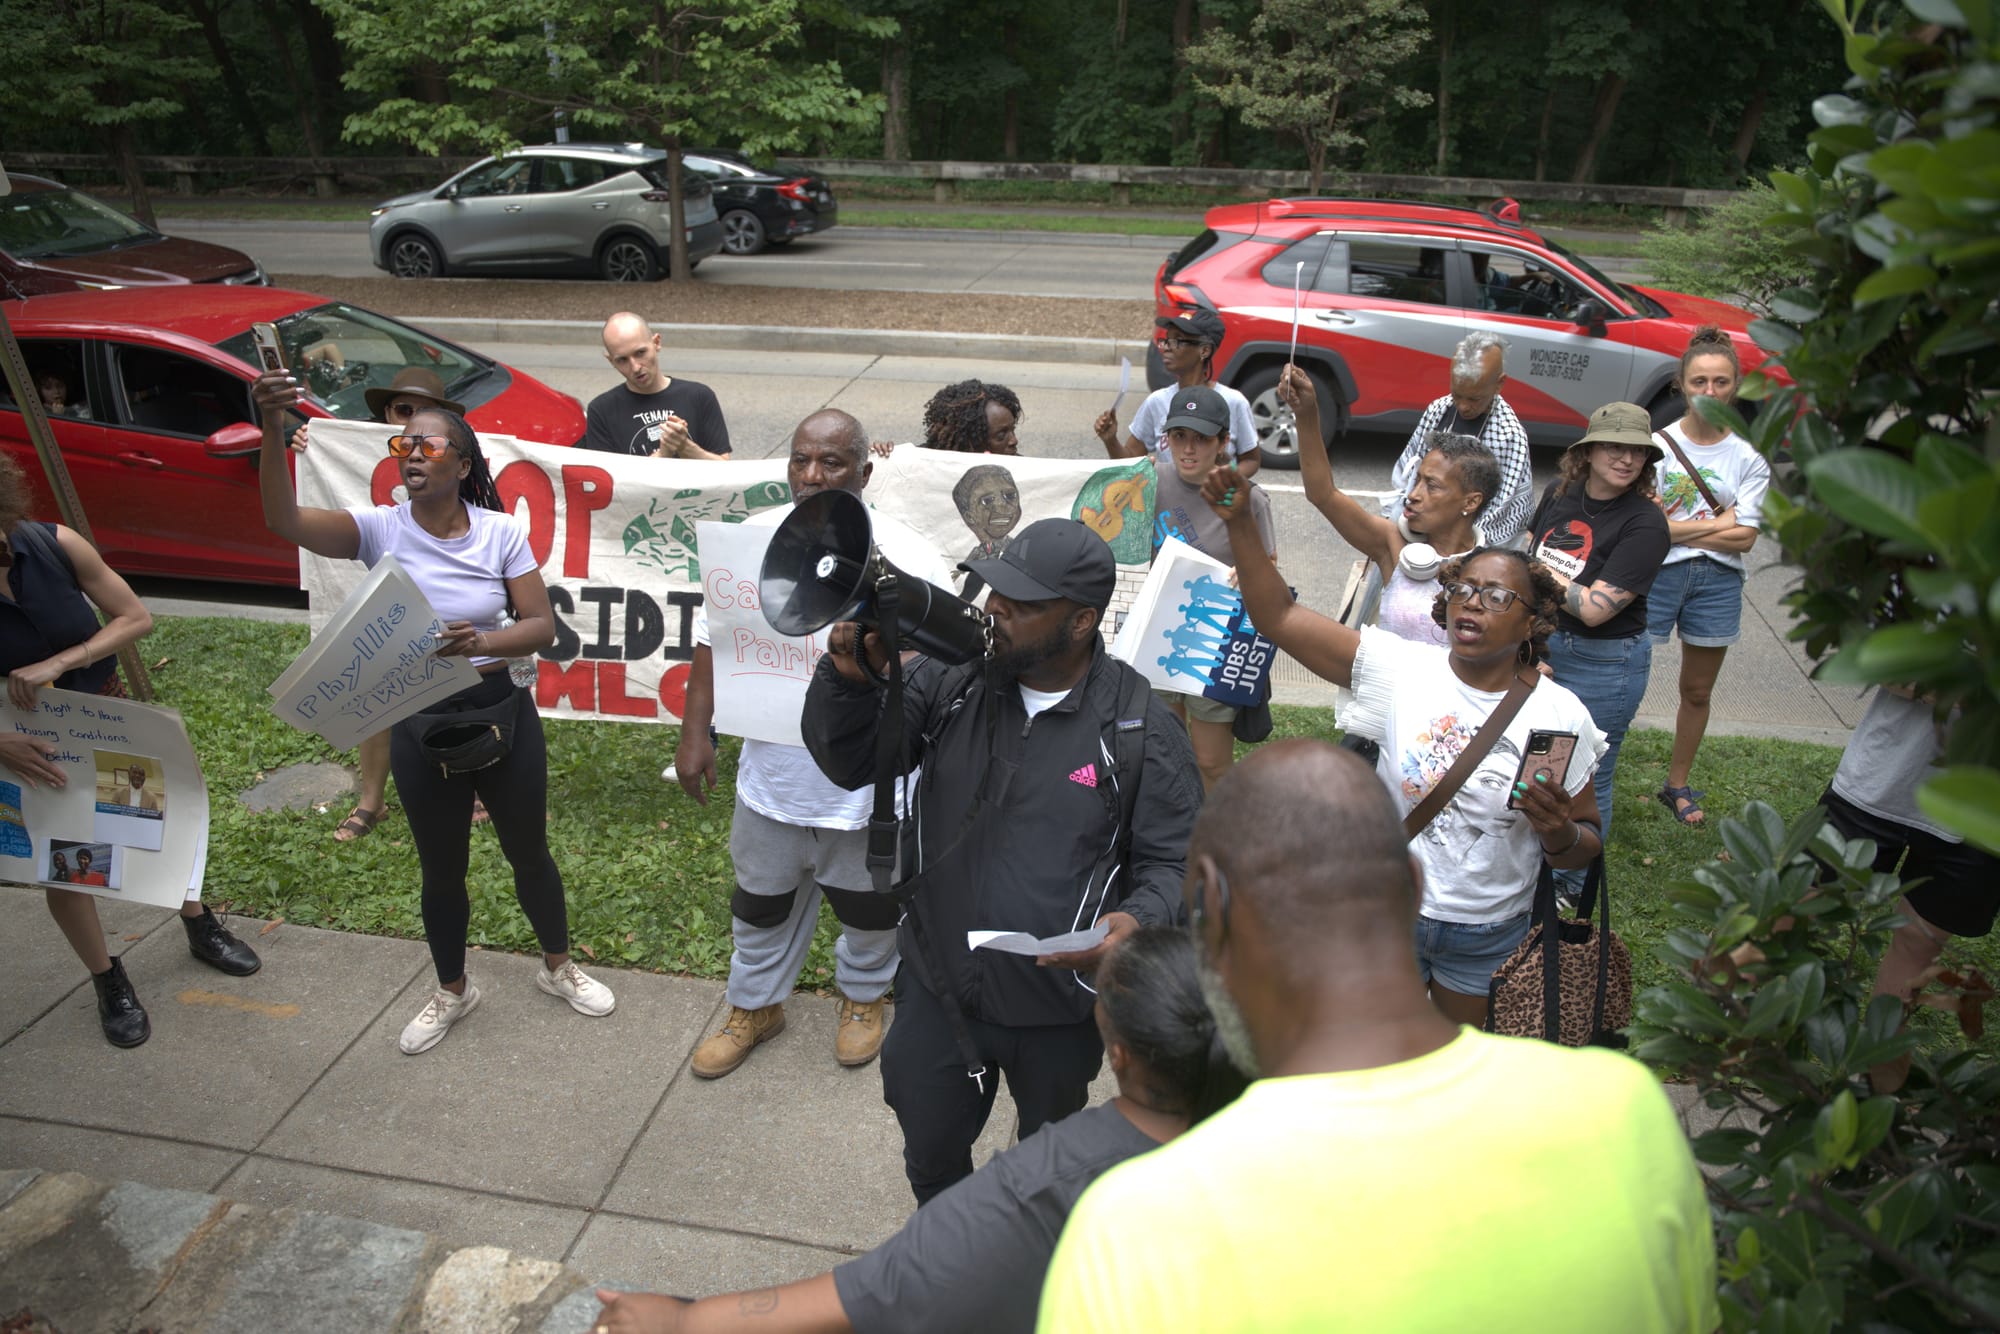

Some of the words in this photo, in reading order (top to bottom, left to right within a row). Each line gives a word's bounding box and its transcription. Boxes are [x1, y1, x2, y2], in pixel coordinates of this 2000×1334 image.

[1530, 348, 1569, 365] WONDER
[1570, 353, 1590, 369] CAB
[633, 409, 675, 425] TENANT
[1542, 550, 1565, 565] Stomp
[1564, 560, 1577, 571] Out
[296, 603, 406, 720] Phyllis
[1220, 641, 1249, 690] JOBS
[341, 654, 454, 719] YWCA
[80, 705, 95, 717] to
[98, 710, 126, 723] Have
[15, 722, 60, 742] Housing
